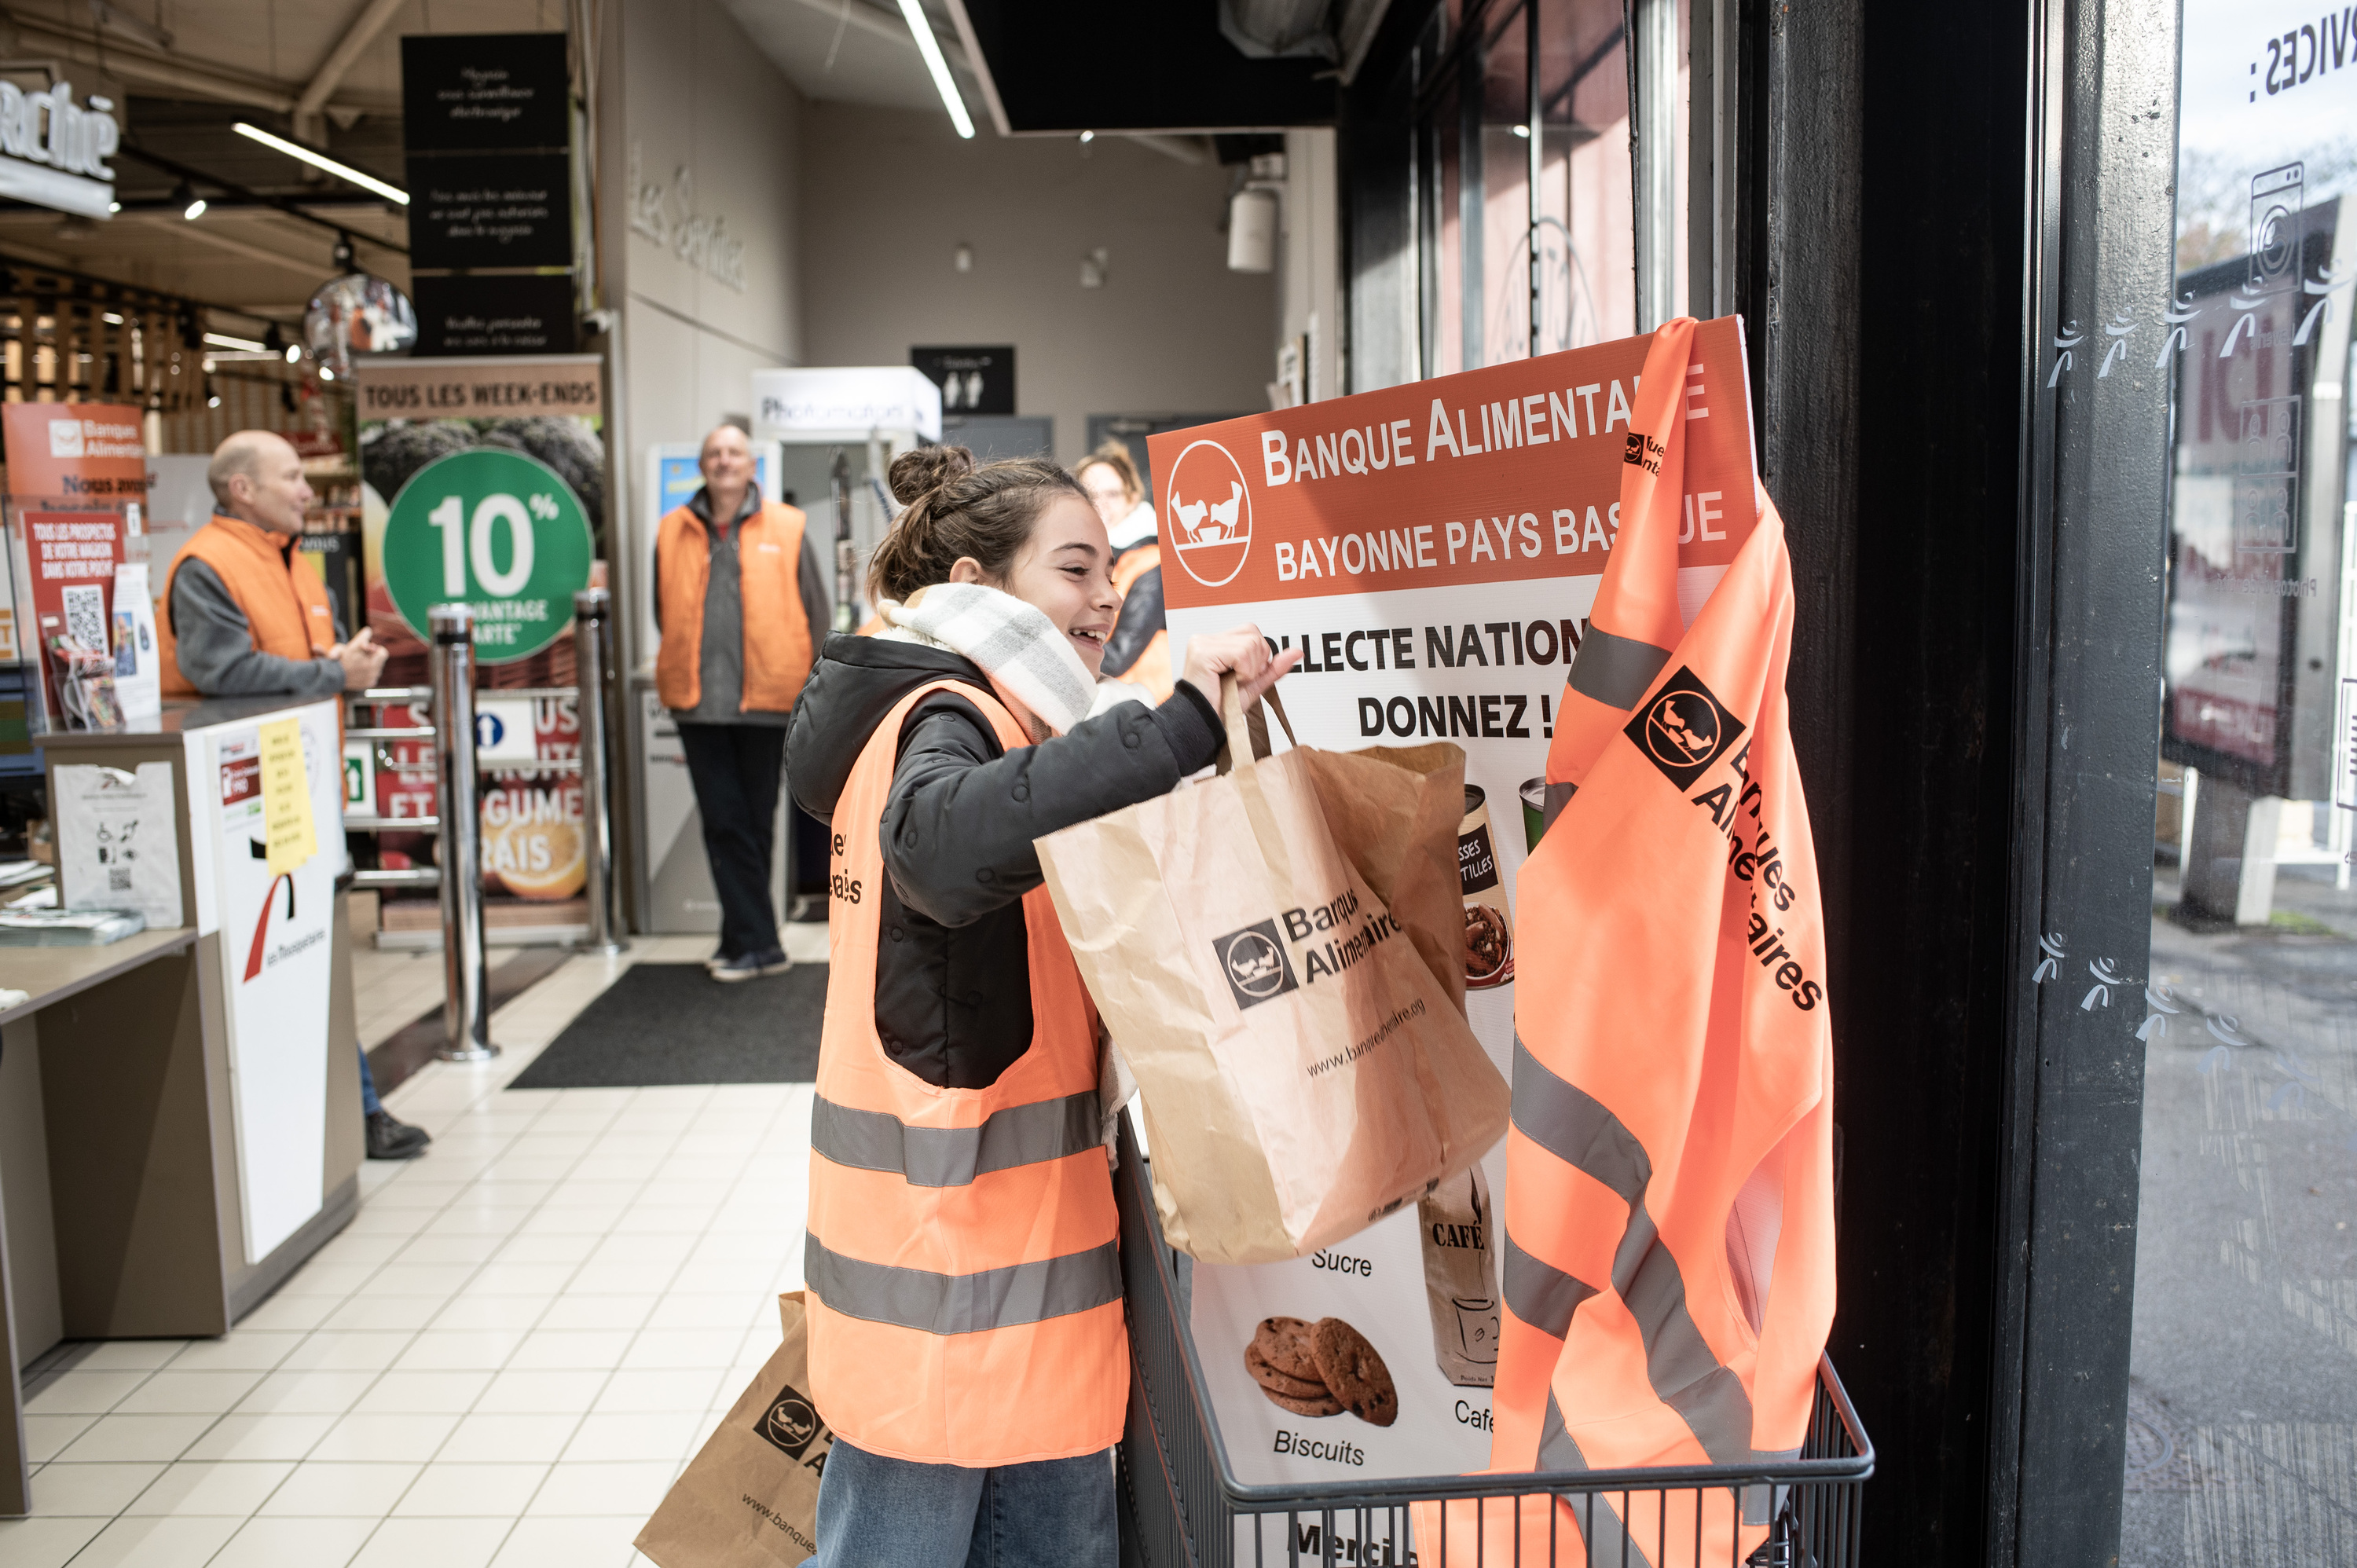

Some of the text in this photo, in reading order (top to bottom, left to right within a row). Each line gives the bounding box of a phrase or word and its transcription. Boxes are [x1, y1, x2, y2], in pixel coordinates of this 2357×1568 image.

[365, 380, 598, 409] TOUS LES WEEK-ENDS
[1261, 363, 1710, 488] BANQUE ALIMENTAE
[32, 522, 55, 541] TOUS
[1275, 490, 1727, 582] BAYONNE PAYS BASUE
[1424, 617, 1589, 669] NATION
[1358, 694, 1530, 738] DONNEZ
[1460, 855, 1494, 882] TILLES
[1432, 1219, 1485, 1250] CAFÉ
[1311, 1248, 1373, 1277] Sucre
[1273, 1430, 1365, 1467] Biscuits
